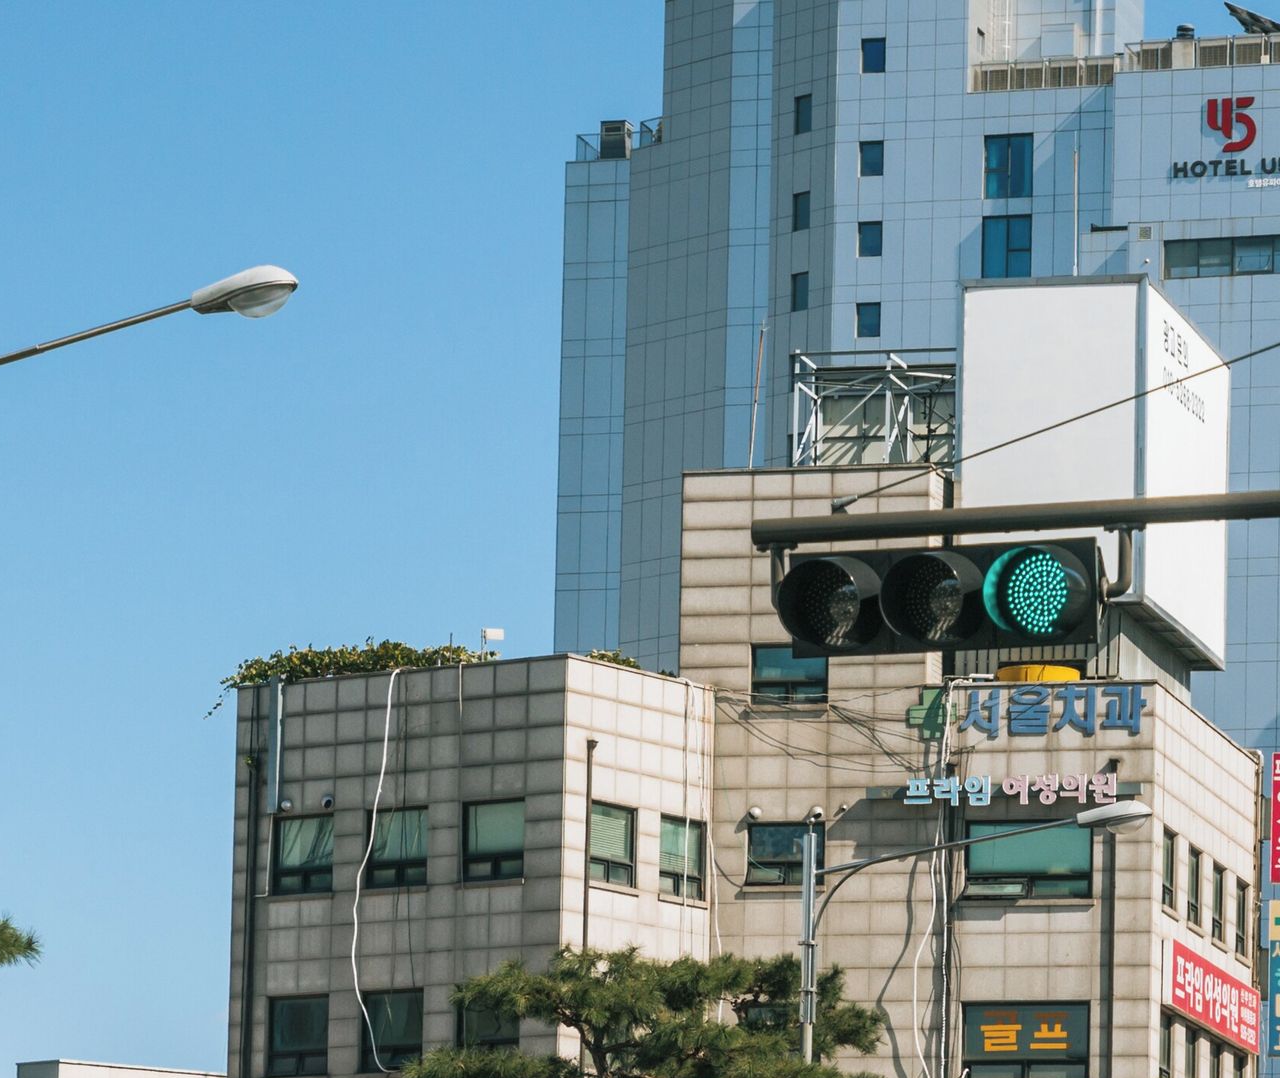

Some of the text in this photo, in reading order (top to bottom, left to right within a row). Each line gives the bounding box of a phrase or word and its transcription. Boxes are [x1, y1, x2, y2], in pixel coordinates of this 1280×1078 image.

[1173, 158, 1252, 178] HOTEL
[960, 684, 1147, 737] 서울치과
[904, 773, 1117, 807] 프라임 여성의원
[980, 1010, 1070, 1052] 골프
